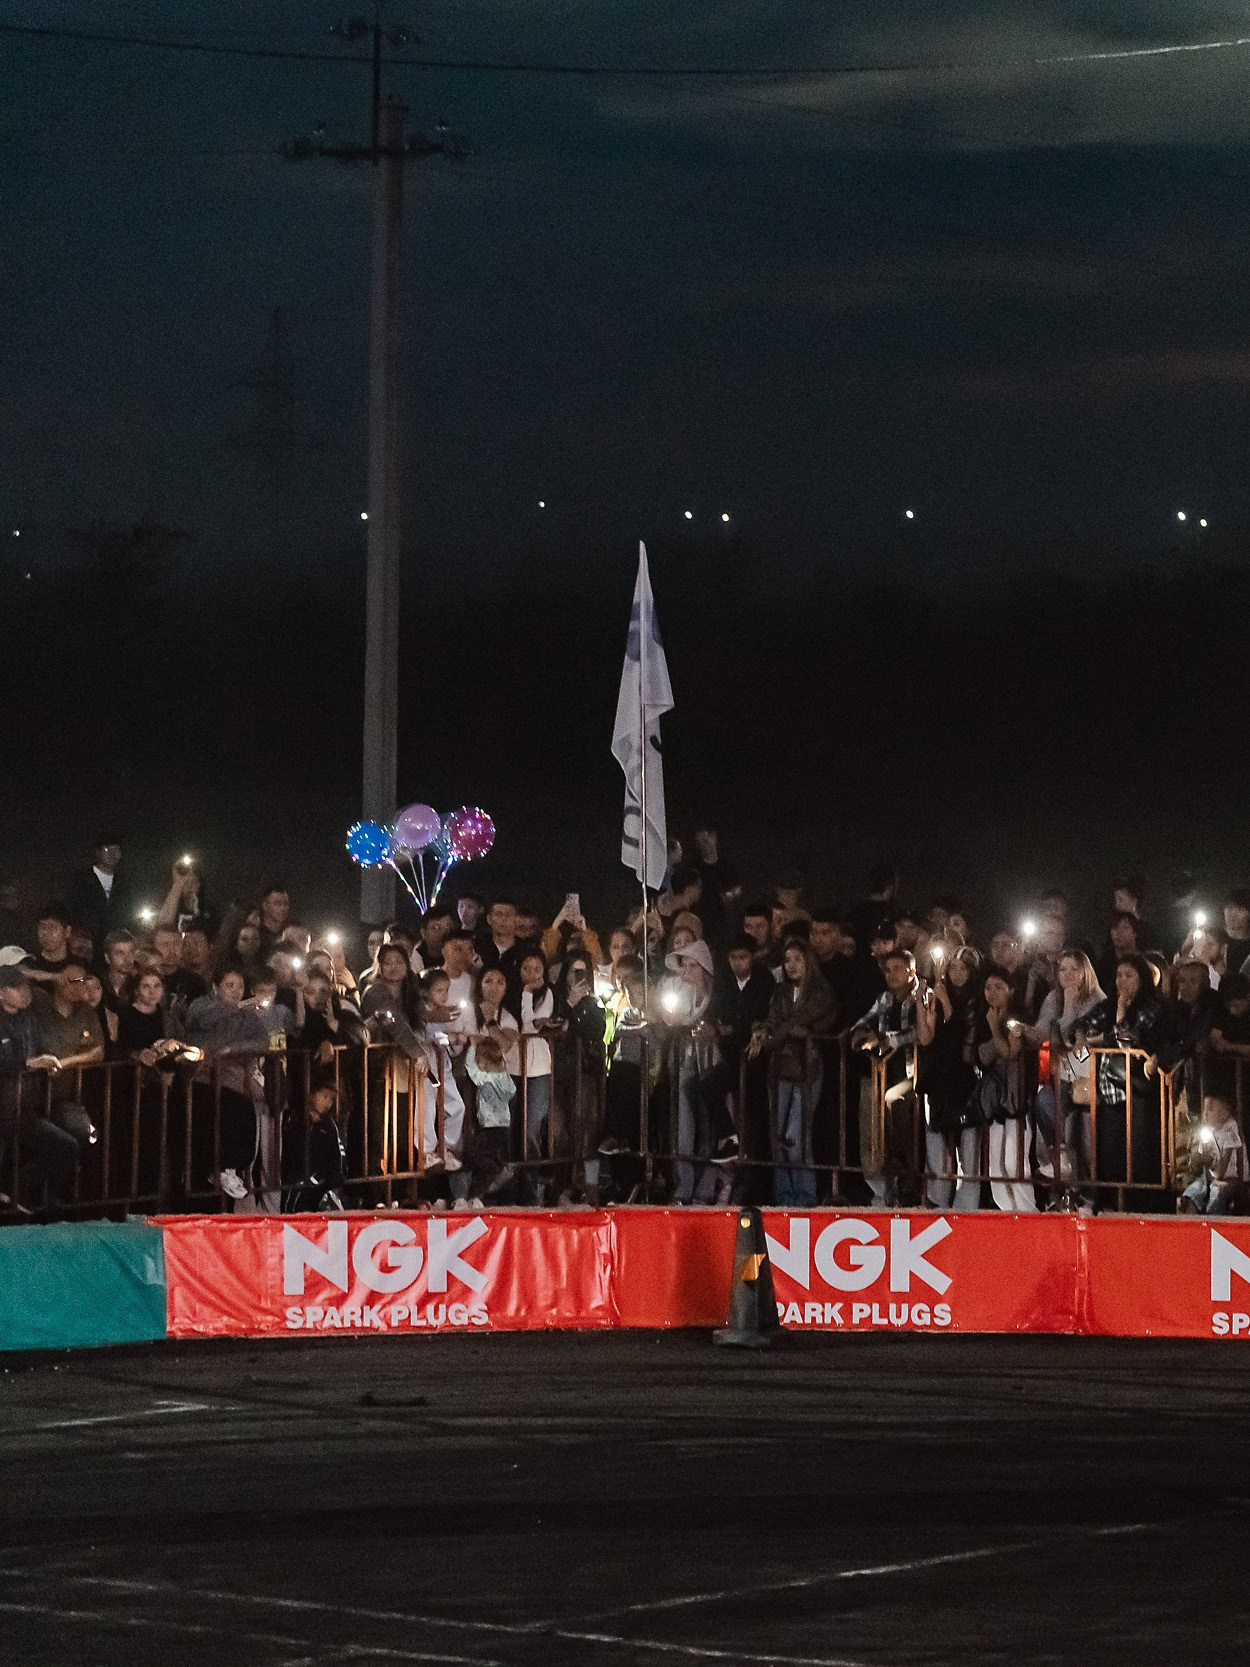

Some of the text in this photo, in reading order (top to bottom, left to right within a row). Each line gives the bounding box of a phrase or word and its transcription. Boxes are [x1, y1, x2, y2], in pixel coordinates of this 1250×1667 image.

[284, 1216, 489, 1295] NGK
[765, 1216, 953, 1295] NGK
[285, 1303, 489, 1330] SPARK PLUGS
[776, 1301, 952, 1326] PARK PLUGS
